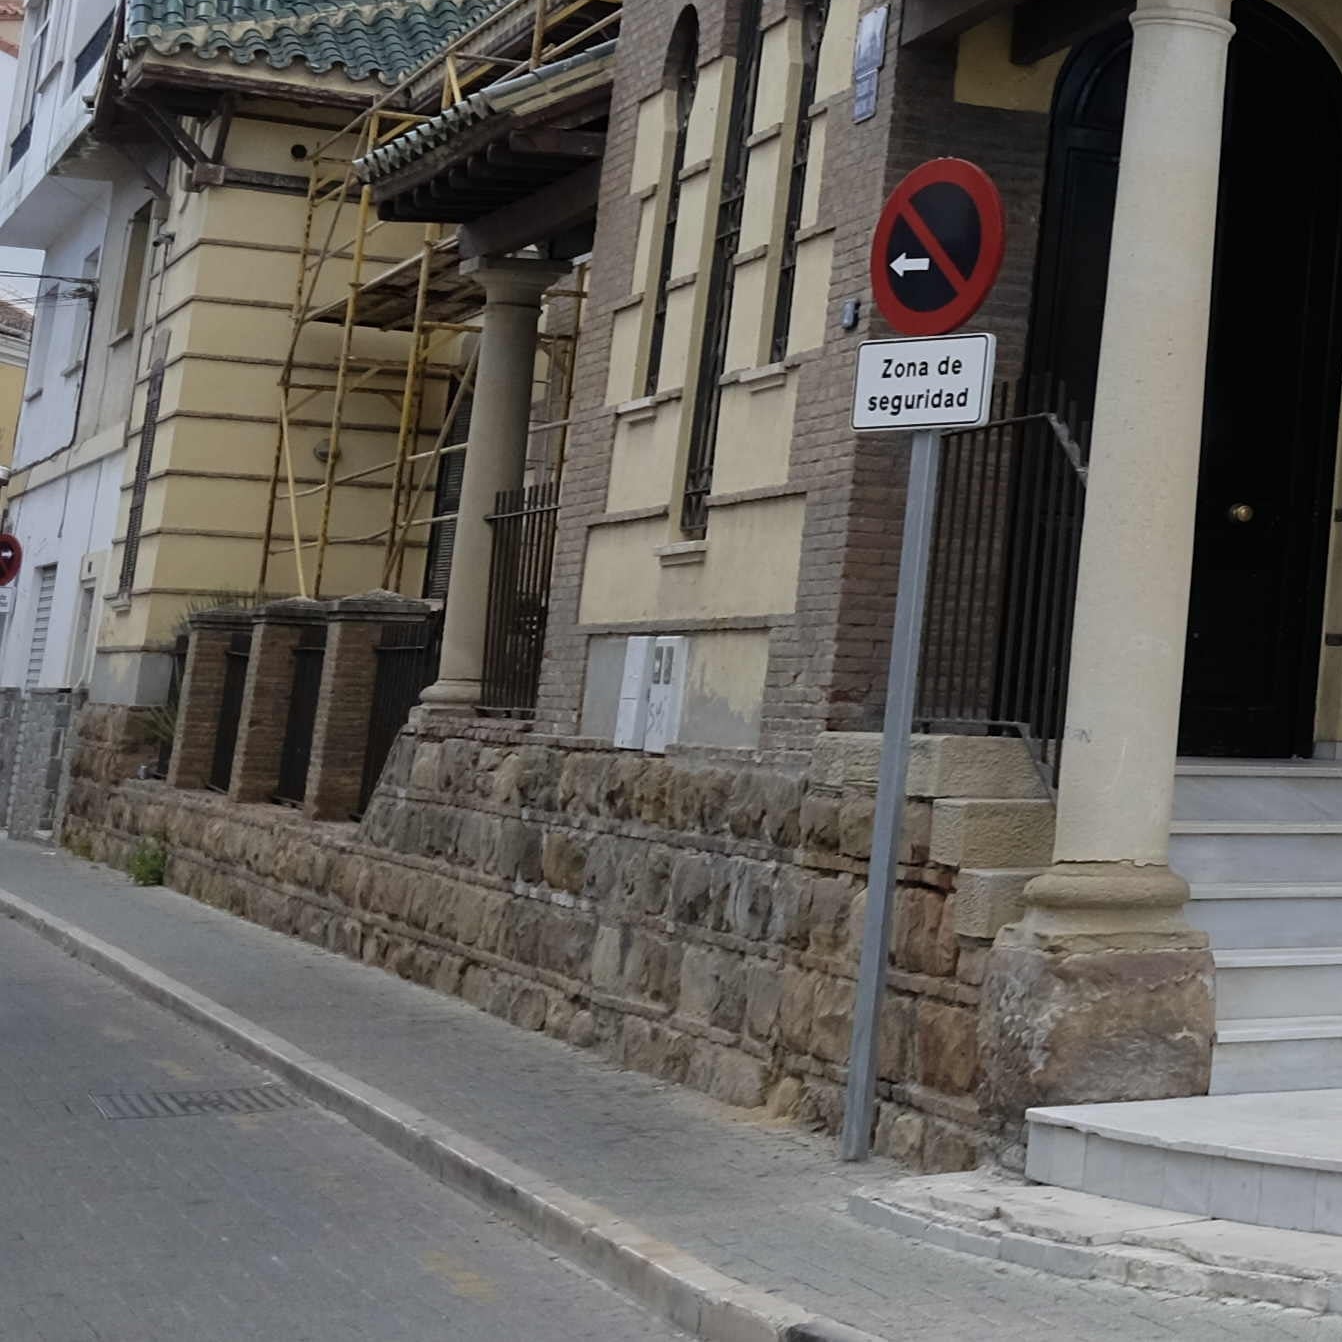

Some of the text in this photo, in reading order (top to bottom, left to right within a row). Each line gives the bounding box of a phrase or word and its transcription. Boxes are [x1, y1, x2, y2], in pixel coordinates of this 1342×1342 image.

[881, 356, 963, 379] Zona de
[867, 387, 969, 416] seguridad
